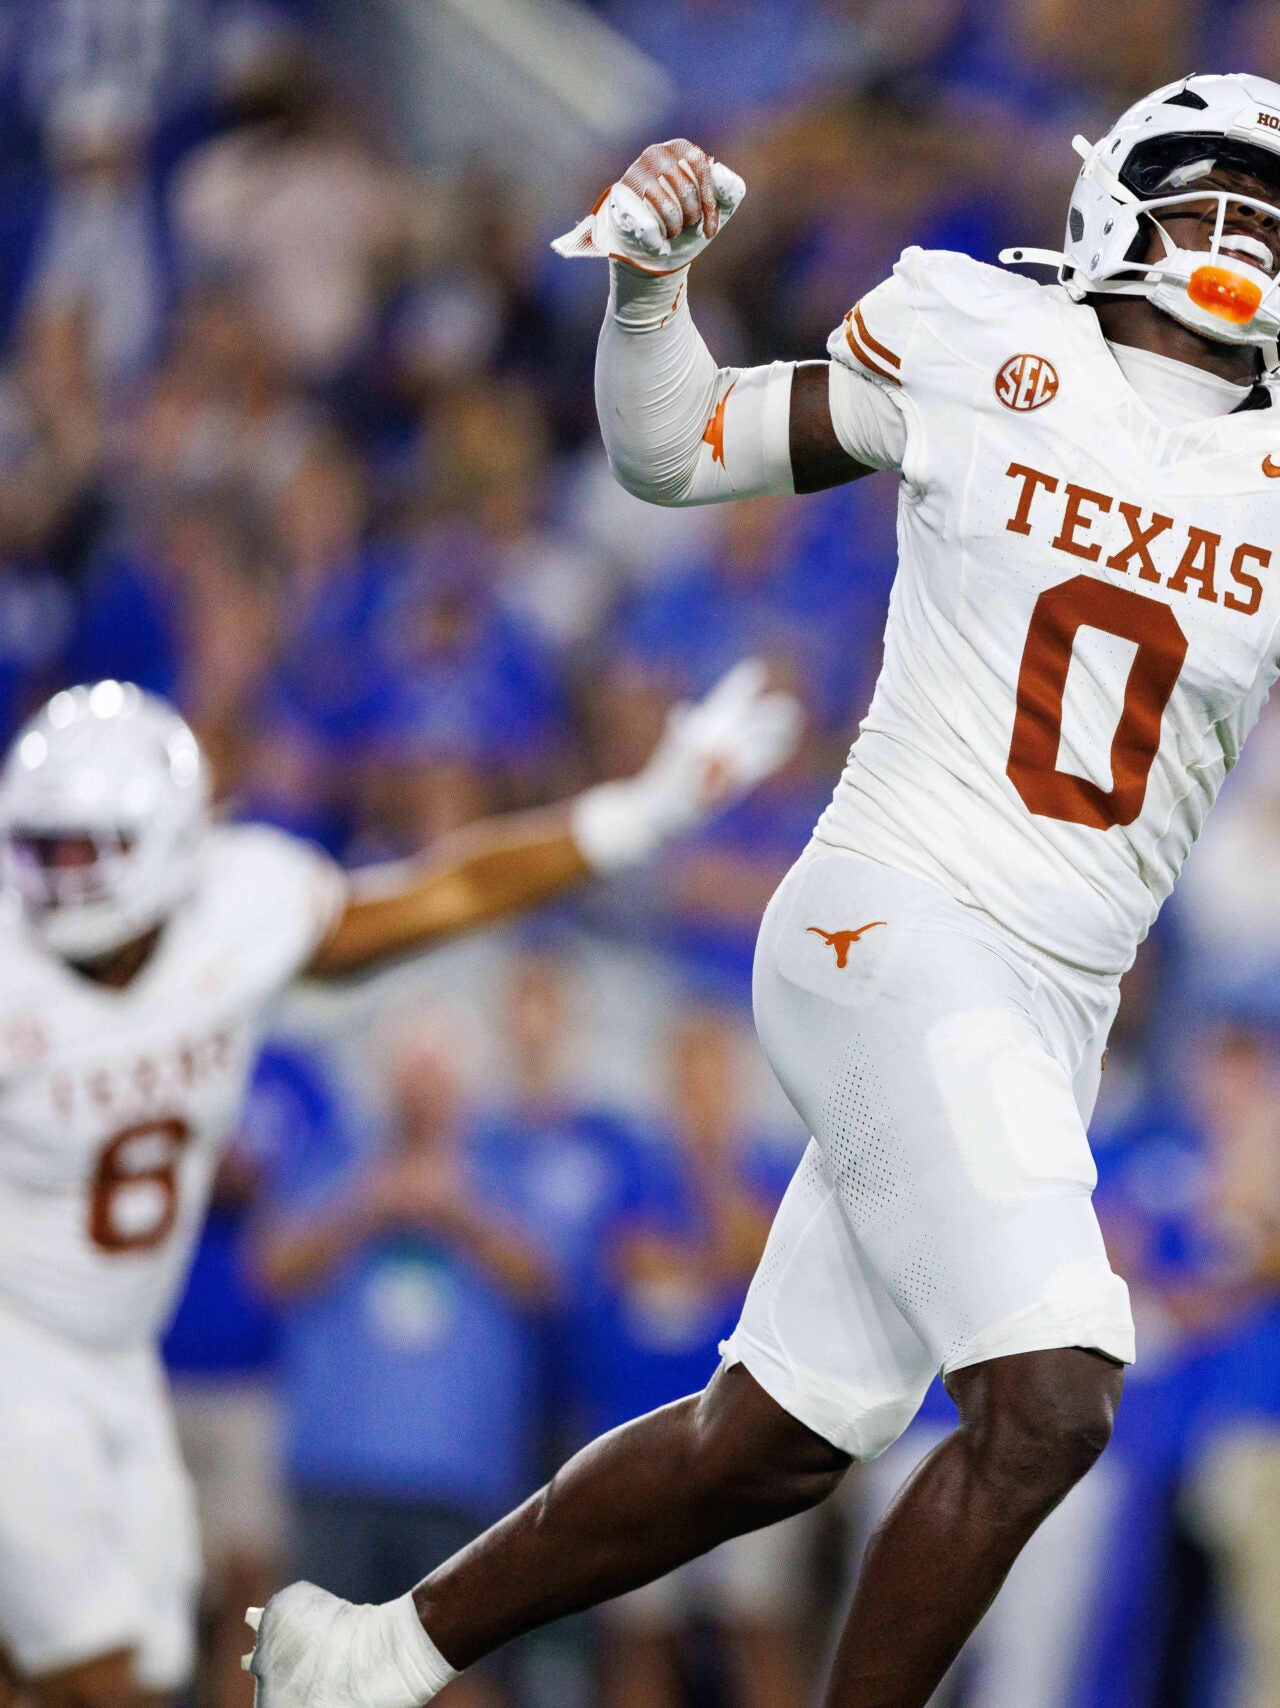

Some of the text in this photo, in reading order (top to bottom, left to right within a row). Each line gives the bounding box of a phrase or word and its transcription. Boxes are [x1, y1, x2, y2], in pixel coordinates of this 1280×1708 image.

[998, 355, 1057, 408] SEC
[1005, 462, 1272, 616] TEXAS
[1006, 574, 1189, 831] 0
[88, 1116, 191, 1254] 6
